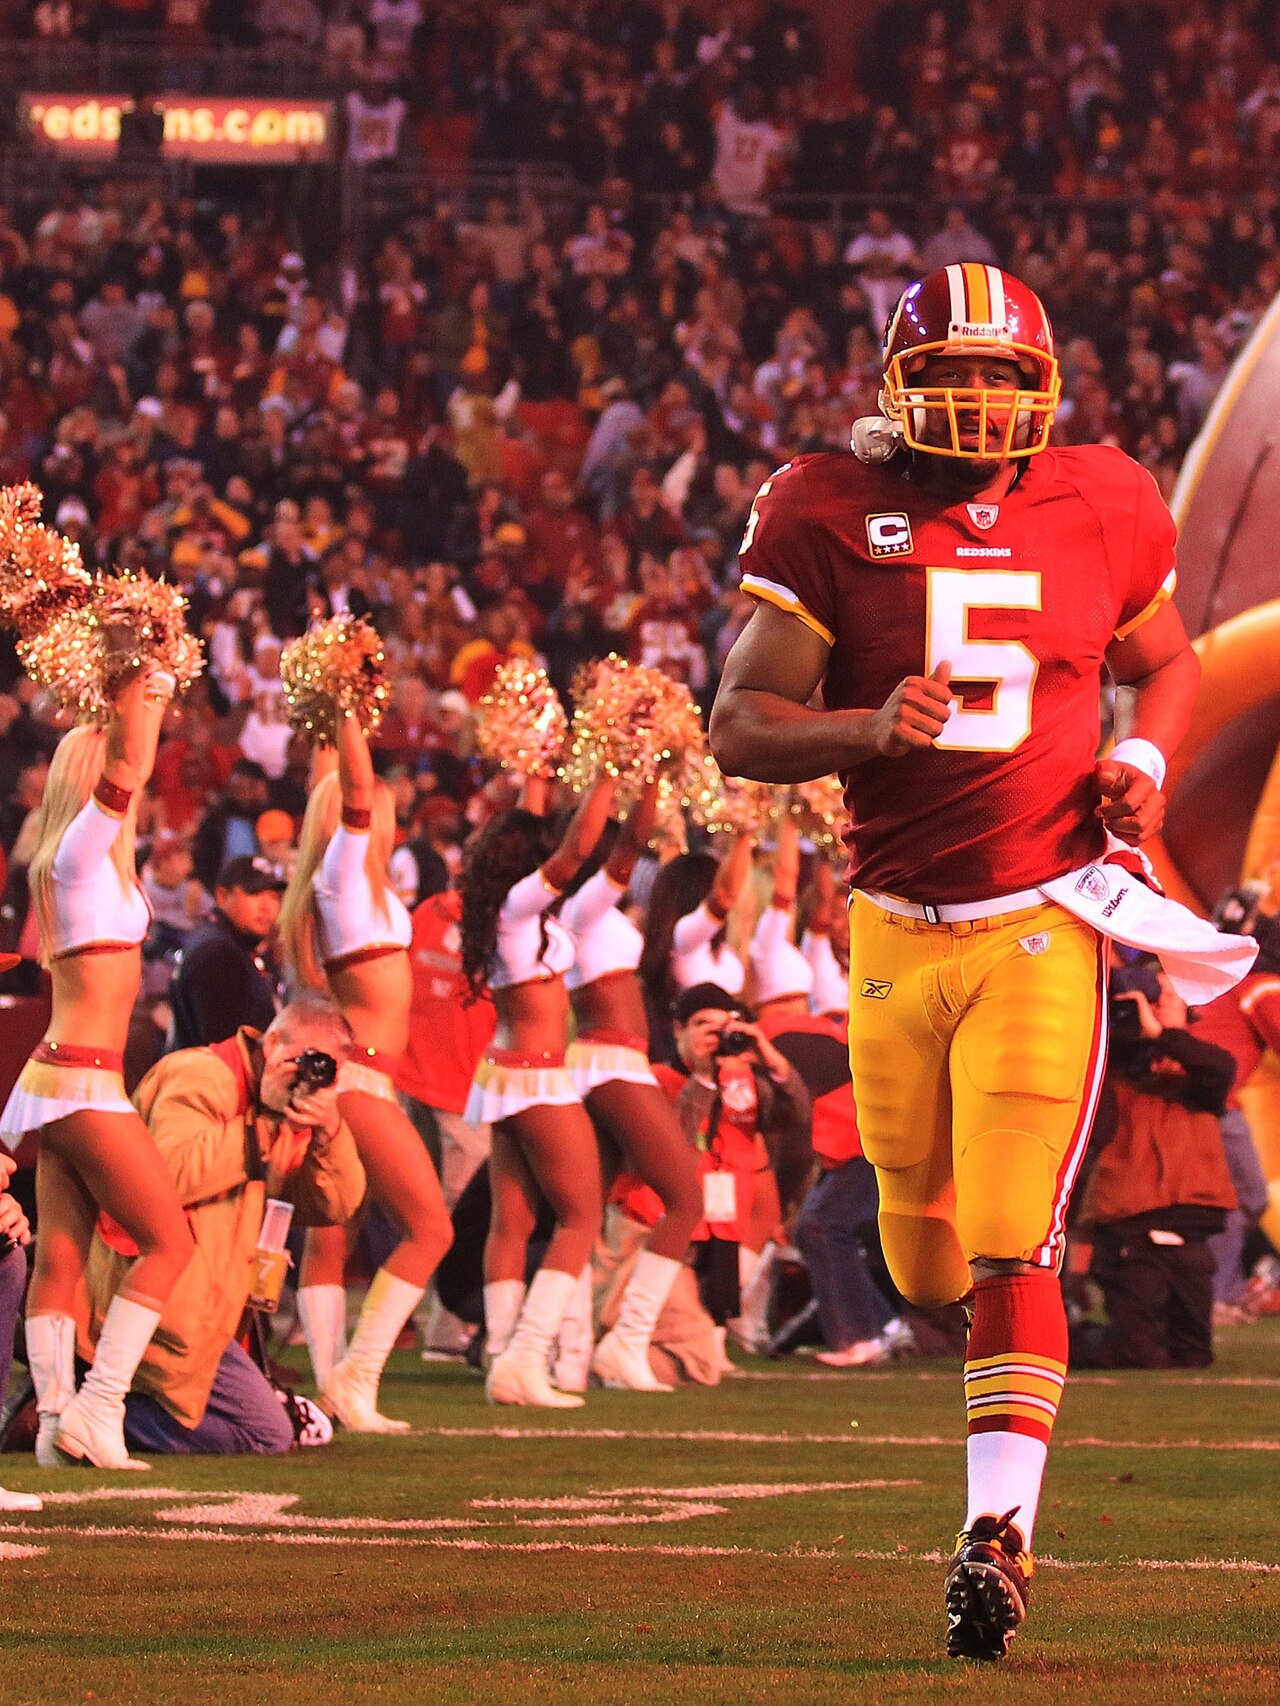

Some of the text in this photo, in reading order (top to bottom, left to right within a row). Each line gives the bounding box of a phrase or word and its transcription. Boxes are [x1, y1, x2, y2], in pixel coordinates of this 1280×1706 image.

[31, 101, 326, 145] edsns.com
[869, 516, 908, 546] C
[955, 547, 1012, 557] REDSKINS
[924, 566, 1043, 753] 5
[1101, 888, 1129, 918] Wilson
